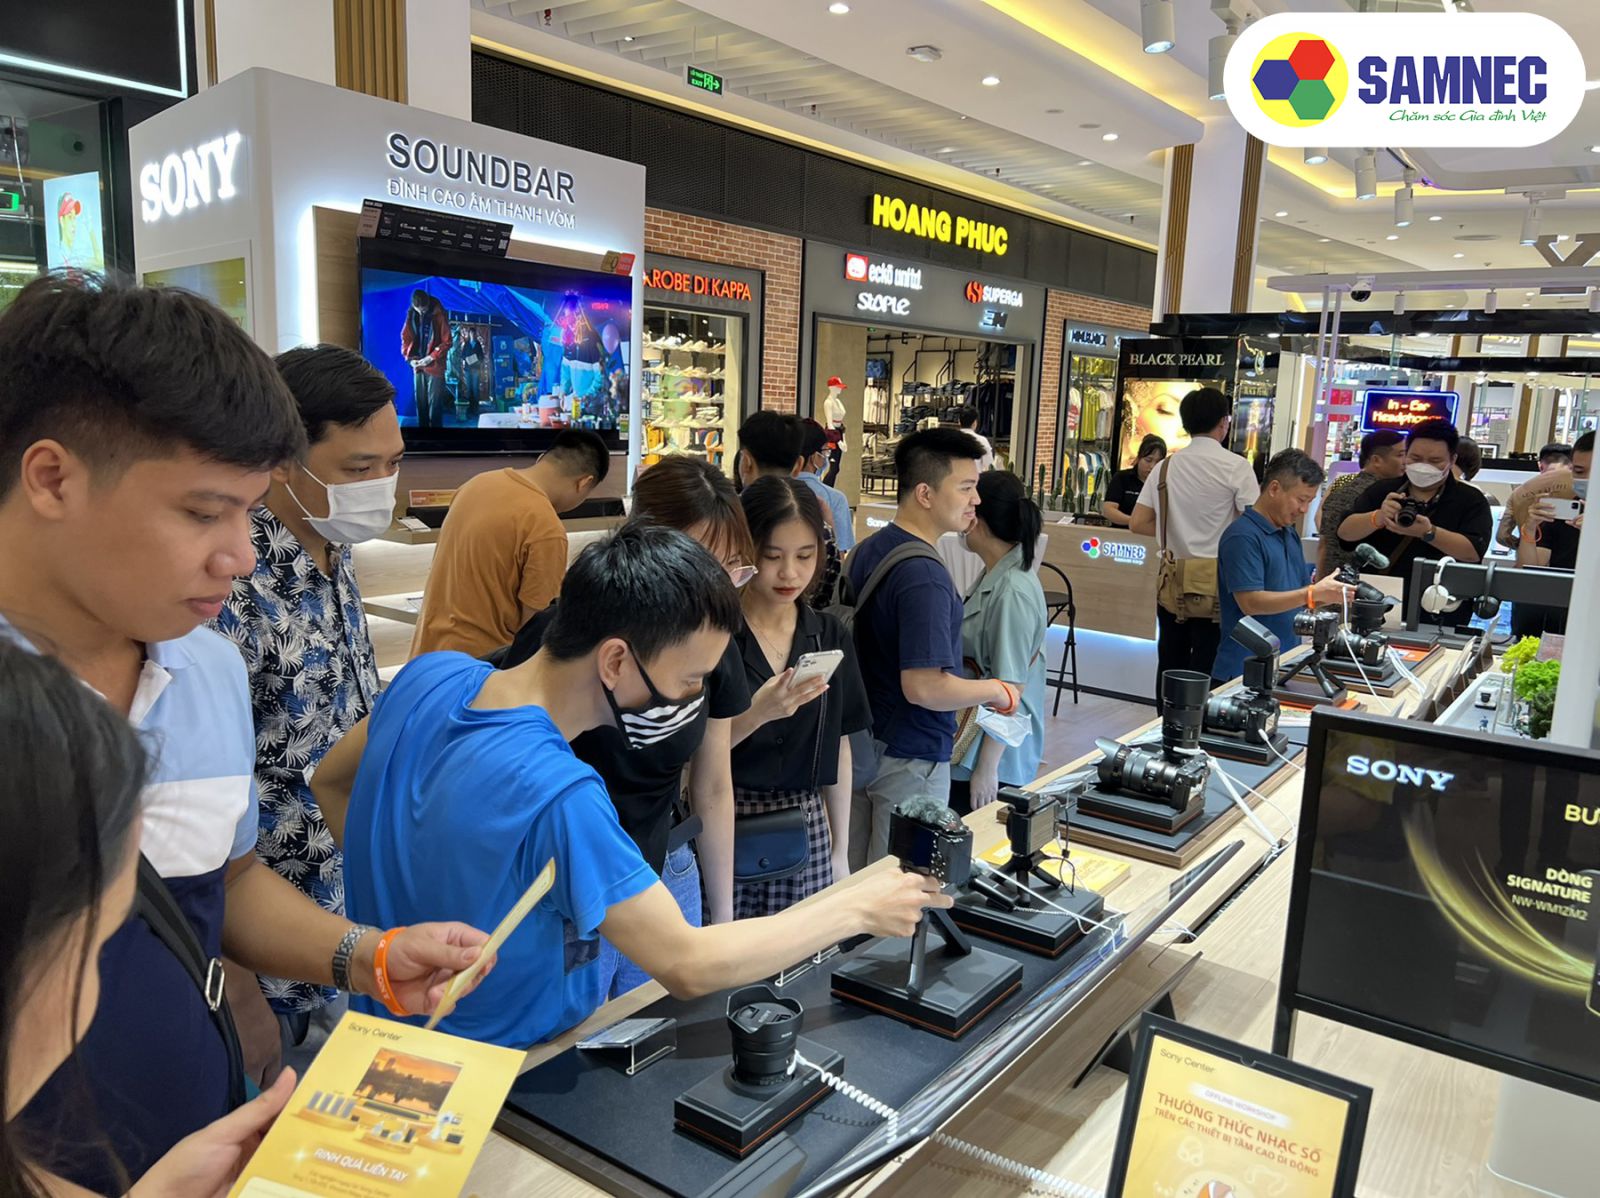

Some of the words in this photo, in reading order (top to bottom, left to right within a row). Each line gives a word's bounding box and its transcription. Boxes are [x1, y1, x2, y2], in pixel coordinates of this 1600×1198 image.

[139, 130, 240, 224] SONY
[386, 131, 575, 204] SOUNDBAR
[432, 188, 466, 208] CAO
[469, 192, 492, 214] ÂM
[494, 199, 543, 223] THANH
[544, 208, 576, 230] VÒM
[872, 193, 952, 242] HOANG
[955, 216, 1008, 256] PHUC
[652, 268, 691, 293] ROBE
[694, 275, 708, 295] DI
[711, 278, 752, 301] KAPPA
[982, 285, 1023, 308] SUPERGA
[1129, 353, 1176, 366] BLACK
[1178, 353, 1225, 366] PEARL
[1103, 541, 1146, 559] SAMNEC
[1346, 755, 1455, 791] SONY
[1507, 874, 1592, 904] SIGNATURE
[1546, 867, 1593, 889] DÒNG
[348, 1022, 371, 1037] Sony
[371, 1028, 402, 1041] Center
[1160, 1048, 1182, 1063] Sony
[1184, 1057, 1215, 1073] Center
[1154, 1107, 1176, 1122] TRÊN
[1177, 1115, 1195, 1129] CÁC
[1255, 1146, 1276, 1160] CAO
[1257, 1130, 1297, 1155] NHẠC
[1301, 1146, 1322, 1163] SỐ
[389, 1168, 409, 1182] TAY
